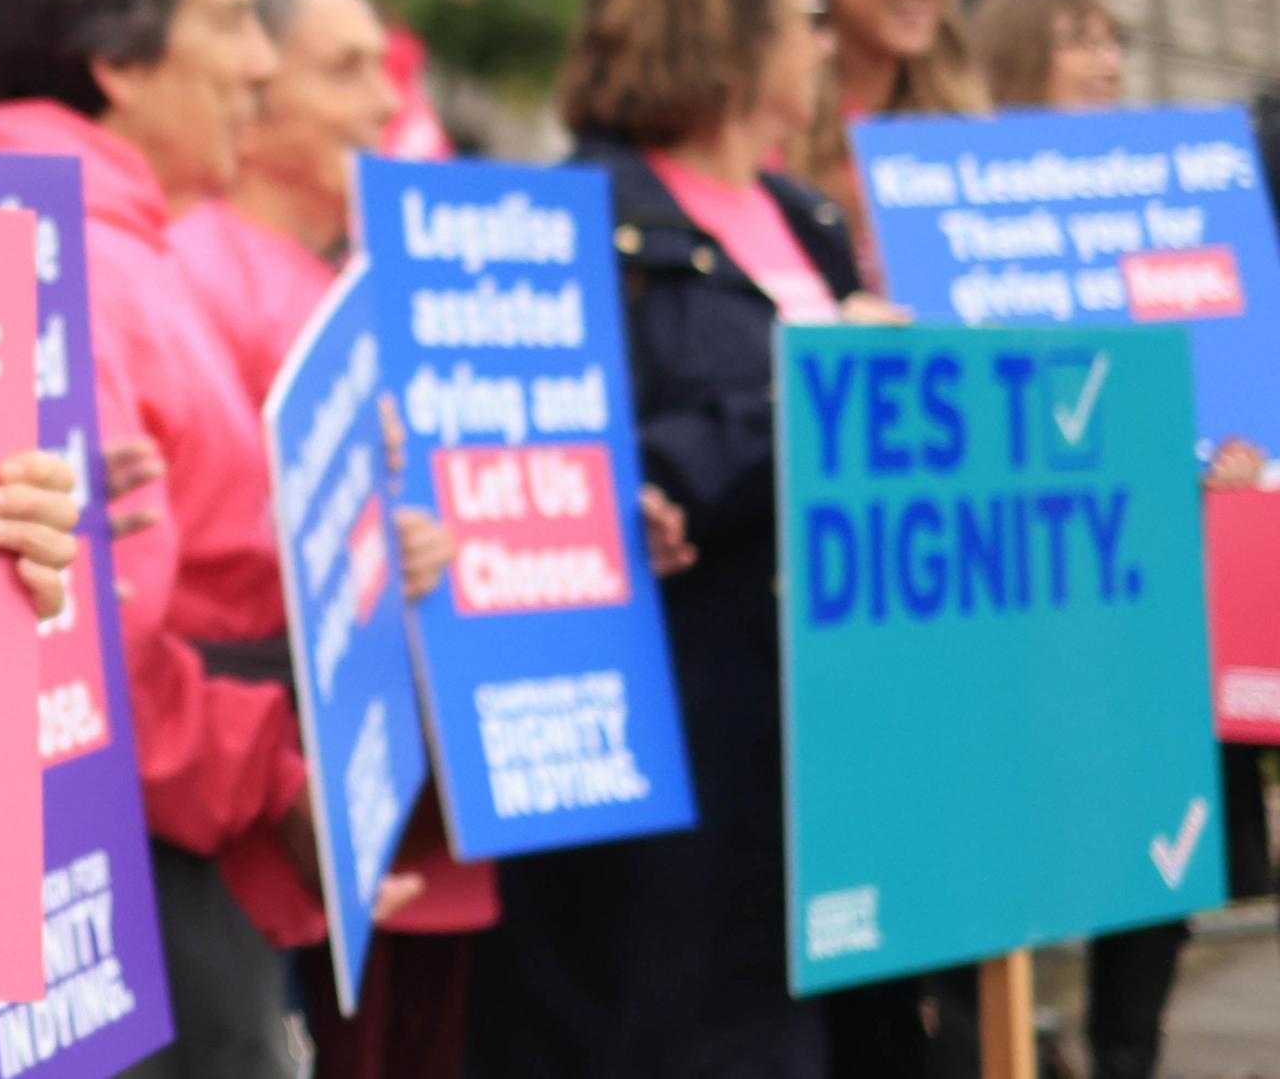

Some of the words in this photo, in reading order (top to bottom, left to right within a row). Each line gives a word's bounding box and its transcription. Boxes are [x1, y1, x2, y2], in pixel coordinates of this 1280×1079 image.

[871, 153, 957, 207] Kim
[402, 190, 574, 273] Legalise
[941, 208, 1064, 261] Thank
[1068, 212, 1142, 263] you
[1143, 201, 1204, 250] for
[412, 278, 583, 348] assisted
[951, 265, 1074, 327] giving
[1074, 268, 1125, 310] us
[406, 364, 527, 447] dying
[531, 366, 607, 432] and
[800, 352, 968, 476] YES
[449, 450, 525, 518] Let
[529, 447, 589, 516] Us
[459, 541, 623, 610] Choose.
[803, 487, 1145, 626] DIGNITY.
